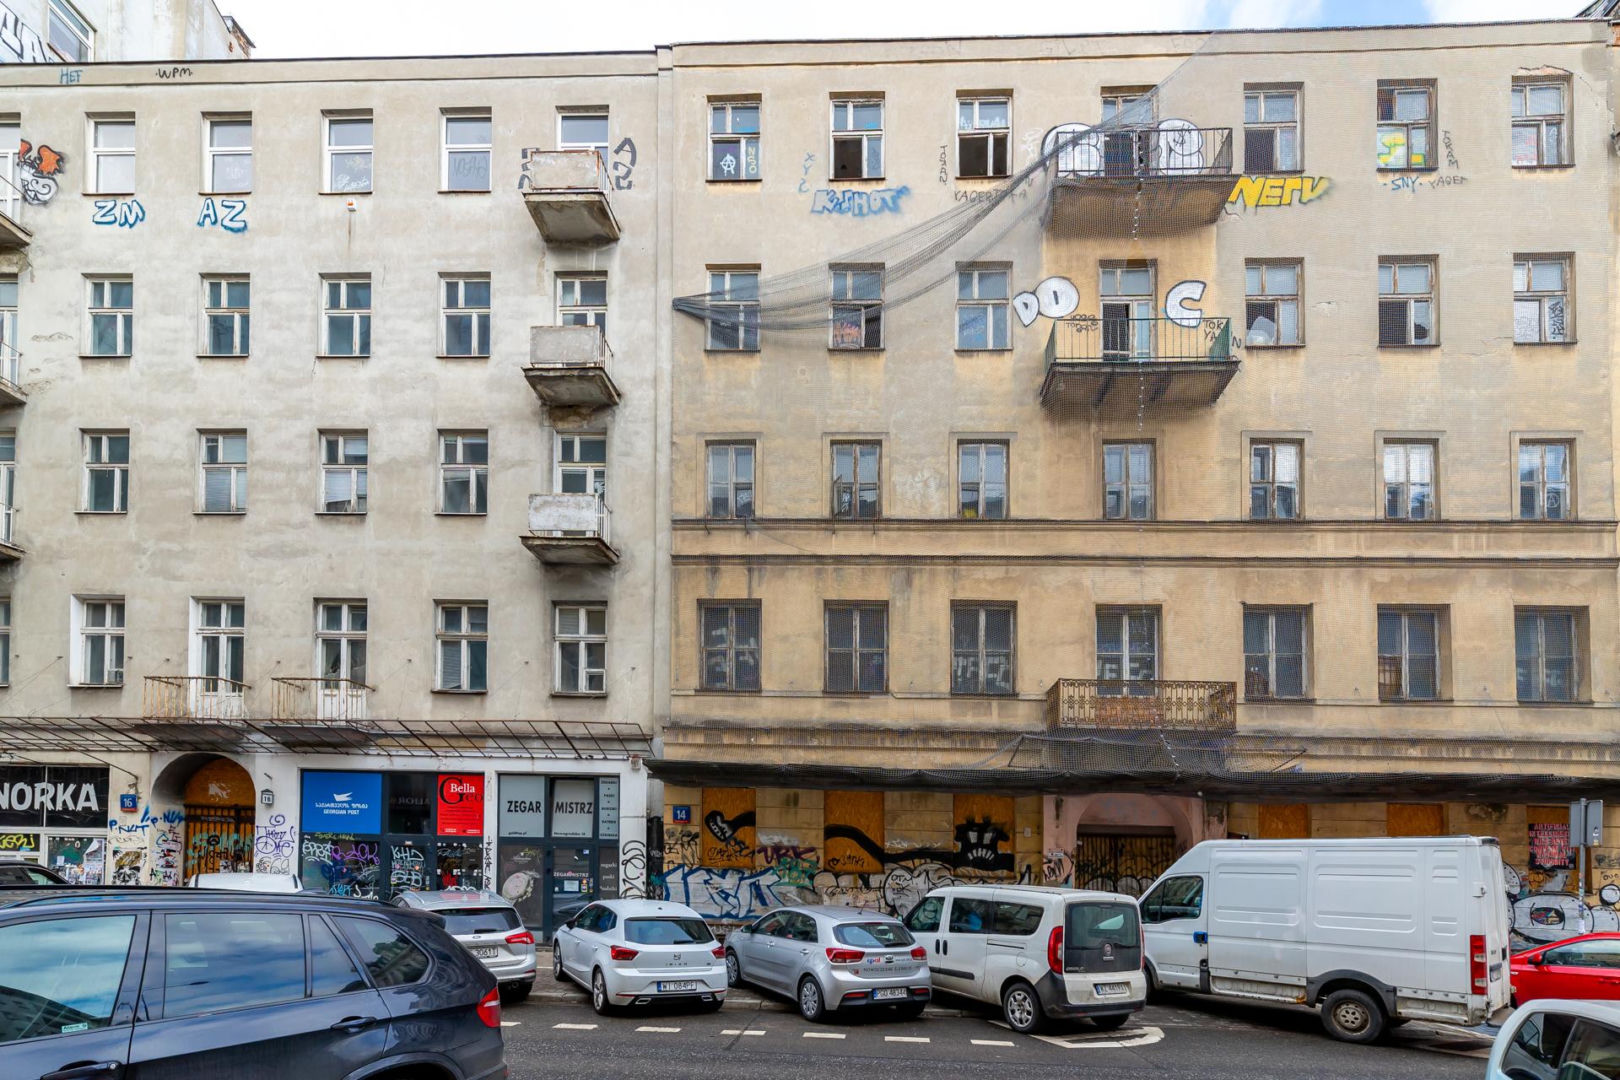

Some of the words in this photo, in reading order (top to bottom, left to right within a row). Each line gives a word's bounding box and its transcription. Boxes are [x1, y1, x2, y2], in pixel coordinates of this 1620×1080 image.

[450, 783, 476, 793] Bella
[123, 798, 133, 808] 16
[507, 800, 542, 813] ZEGAR
[554, 801, 593, 815] MISTRZ
[676, 809, 687, 820] 14
